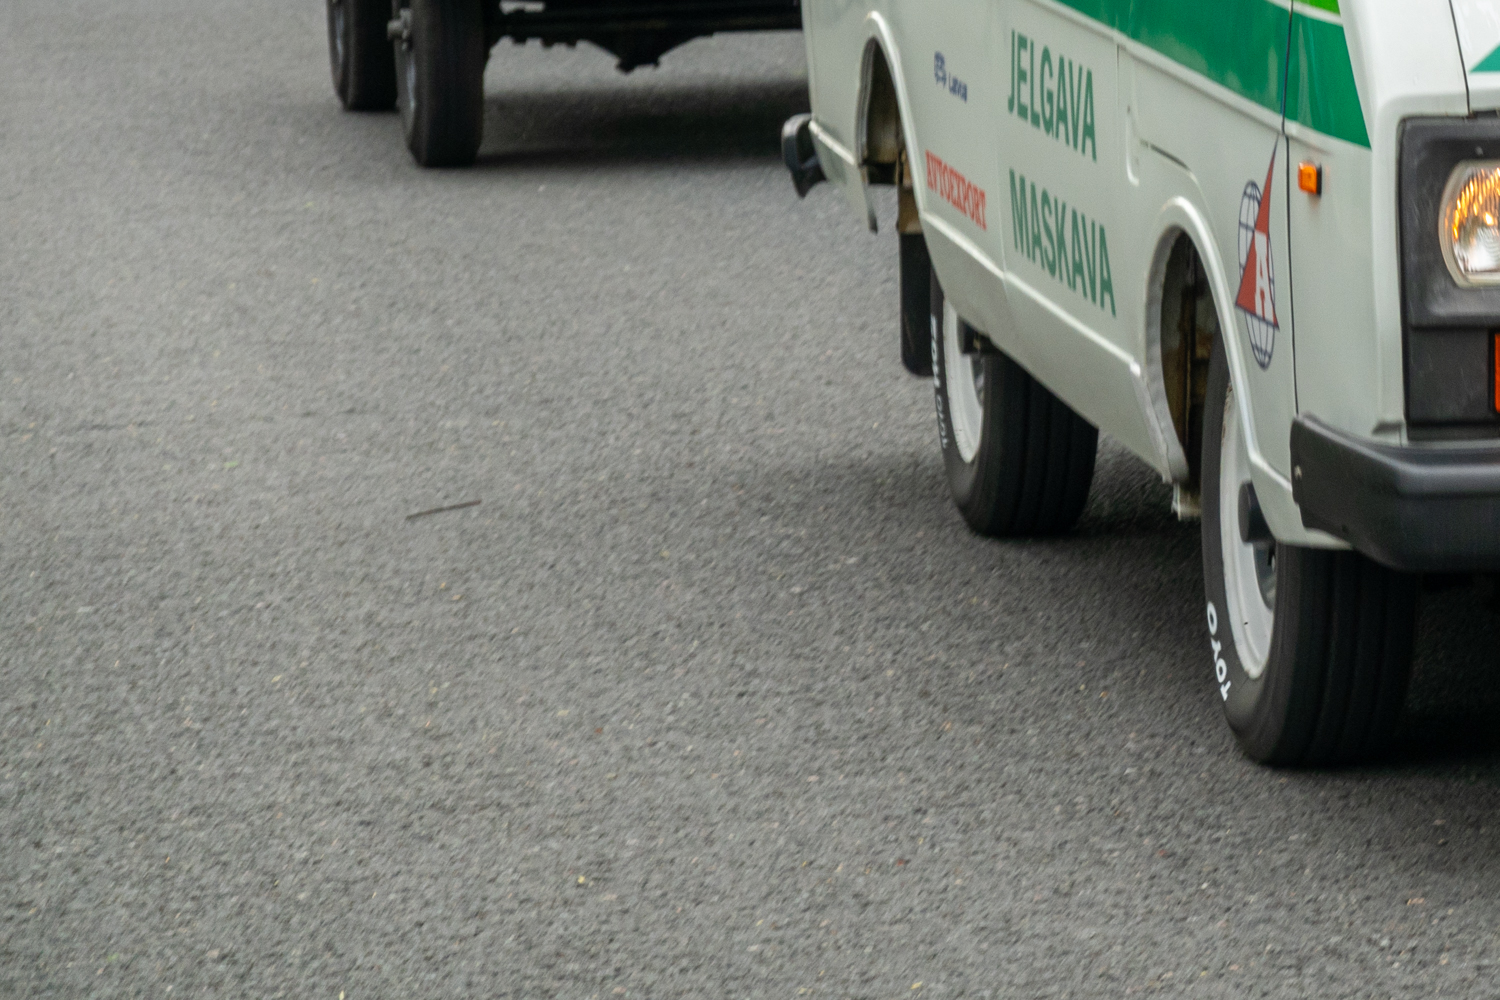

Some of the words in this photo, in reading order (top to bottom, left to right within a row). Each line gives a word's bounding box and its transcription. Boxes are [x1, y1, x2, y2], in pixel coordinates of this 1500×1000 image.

[1007, 28, 1098, 163] JELGAVA
[925, 149, 988, 231] AVTOEXPORT
[1008, 167, 1118, 319] MASKAVA
[1206, 600, 1232, 702] TOYO
